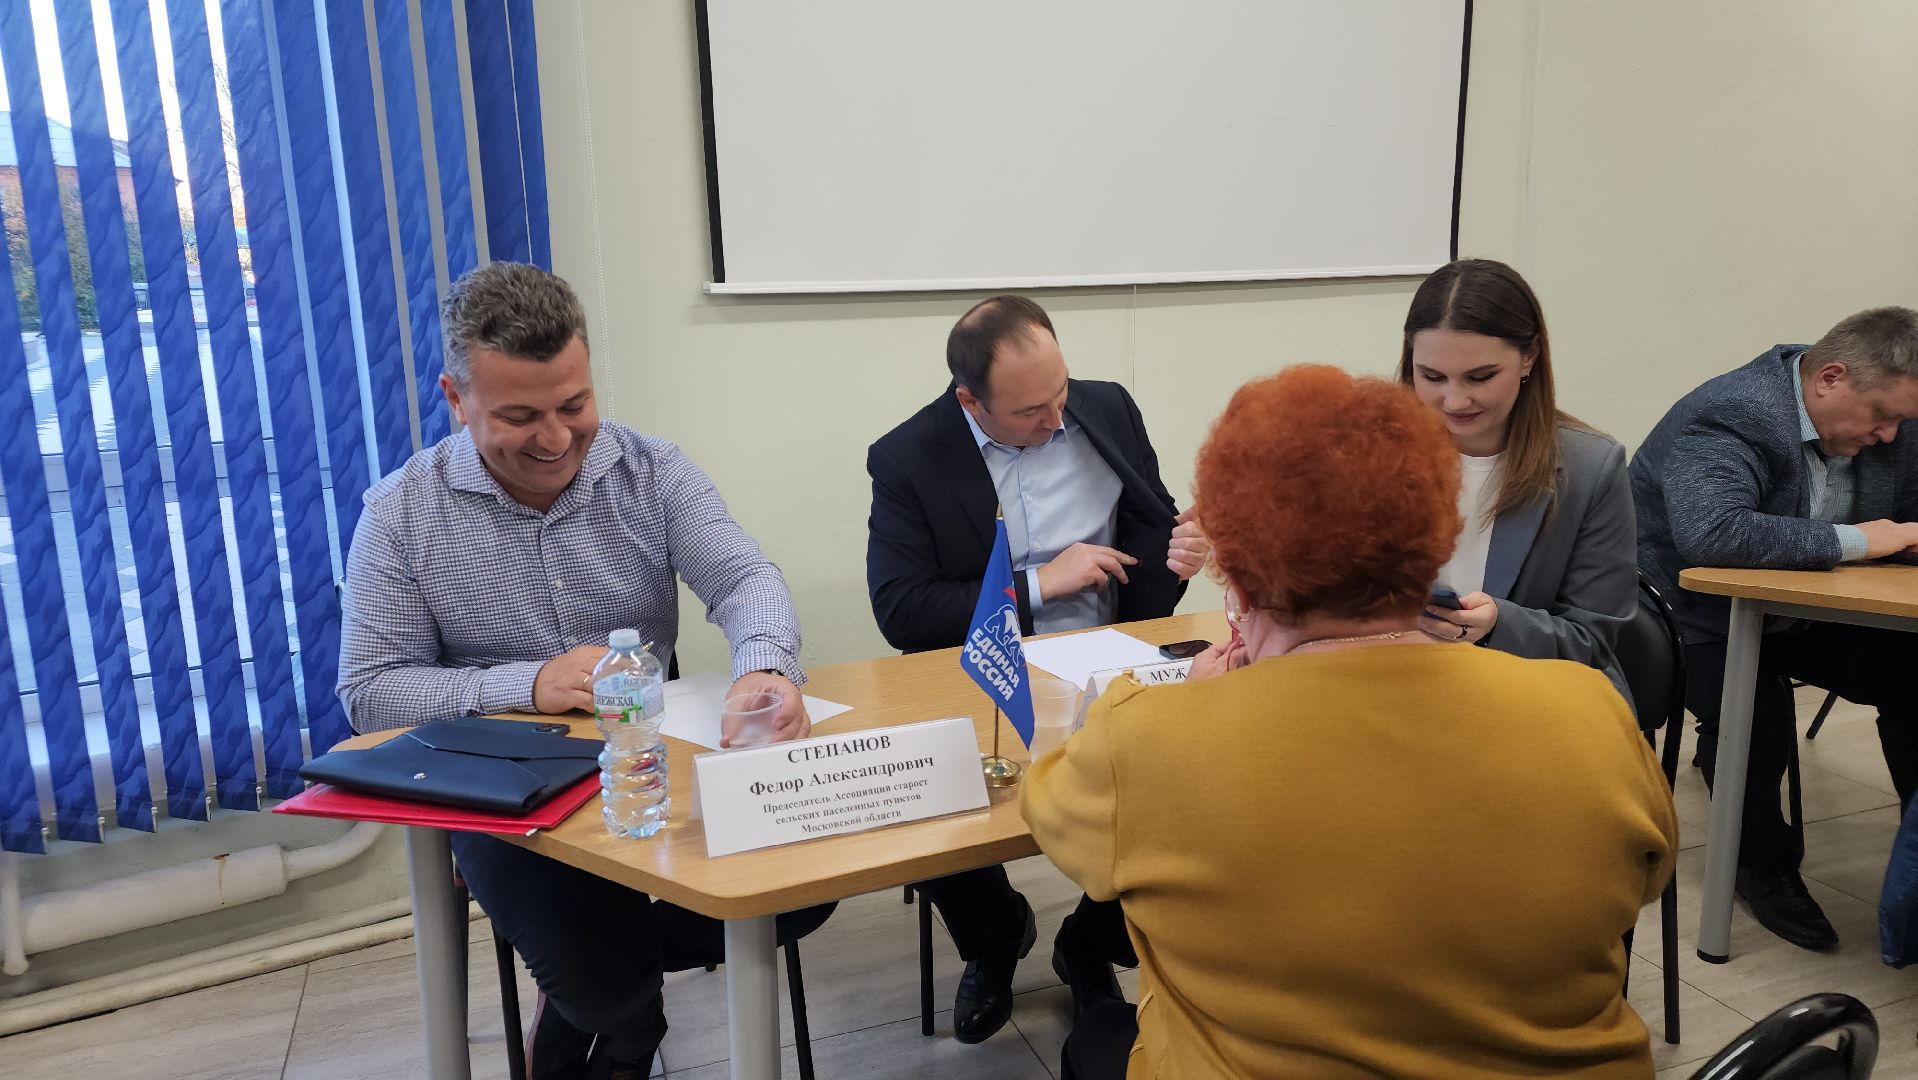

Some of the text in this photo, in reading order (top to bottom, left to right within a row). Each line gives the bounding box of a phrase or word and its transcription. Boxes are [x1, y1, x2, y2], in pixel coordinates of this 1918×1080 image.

[964, 640, 1015, 701] РОССИЯ
[971, 627, 1020, 689] ЕДИНАЯ
[787, 734, 891, 764] СТЕПАНОВ
[749, 755, 934, 796] Федор Александрович
[762, 778, 929, 814] Председатель Ассоциации старост
[775, 793, 922, 825] сельских населенных пунктов
[801, 809, 902, 834] Московской области
